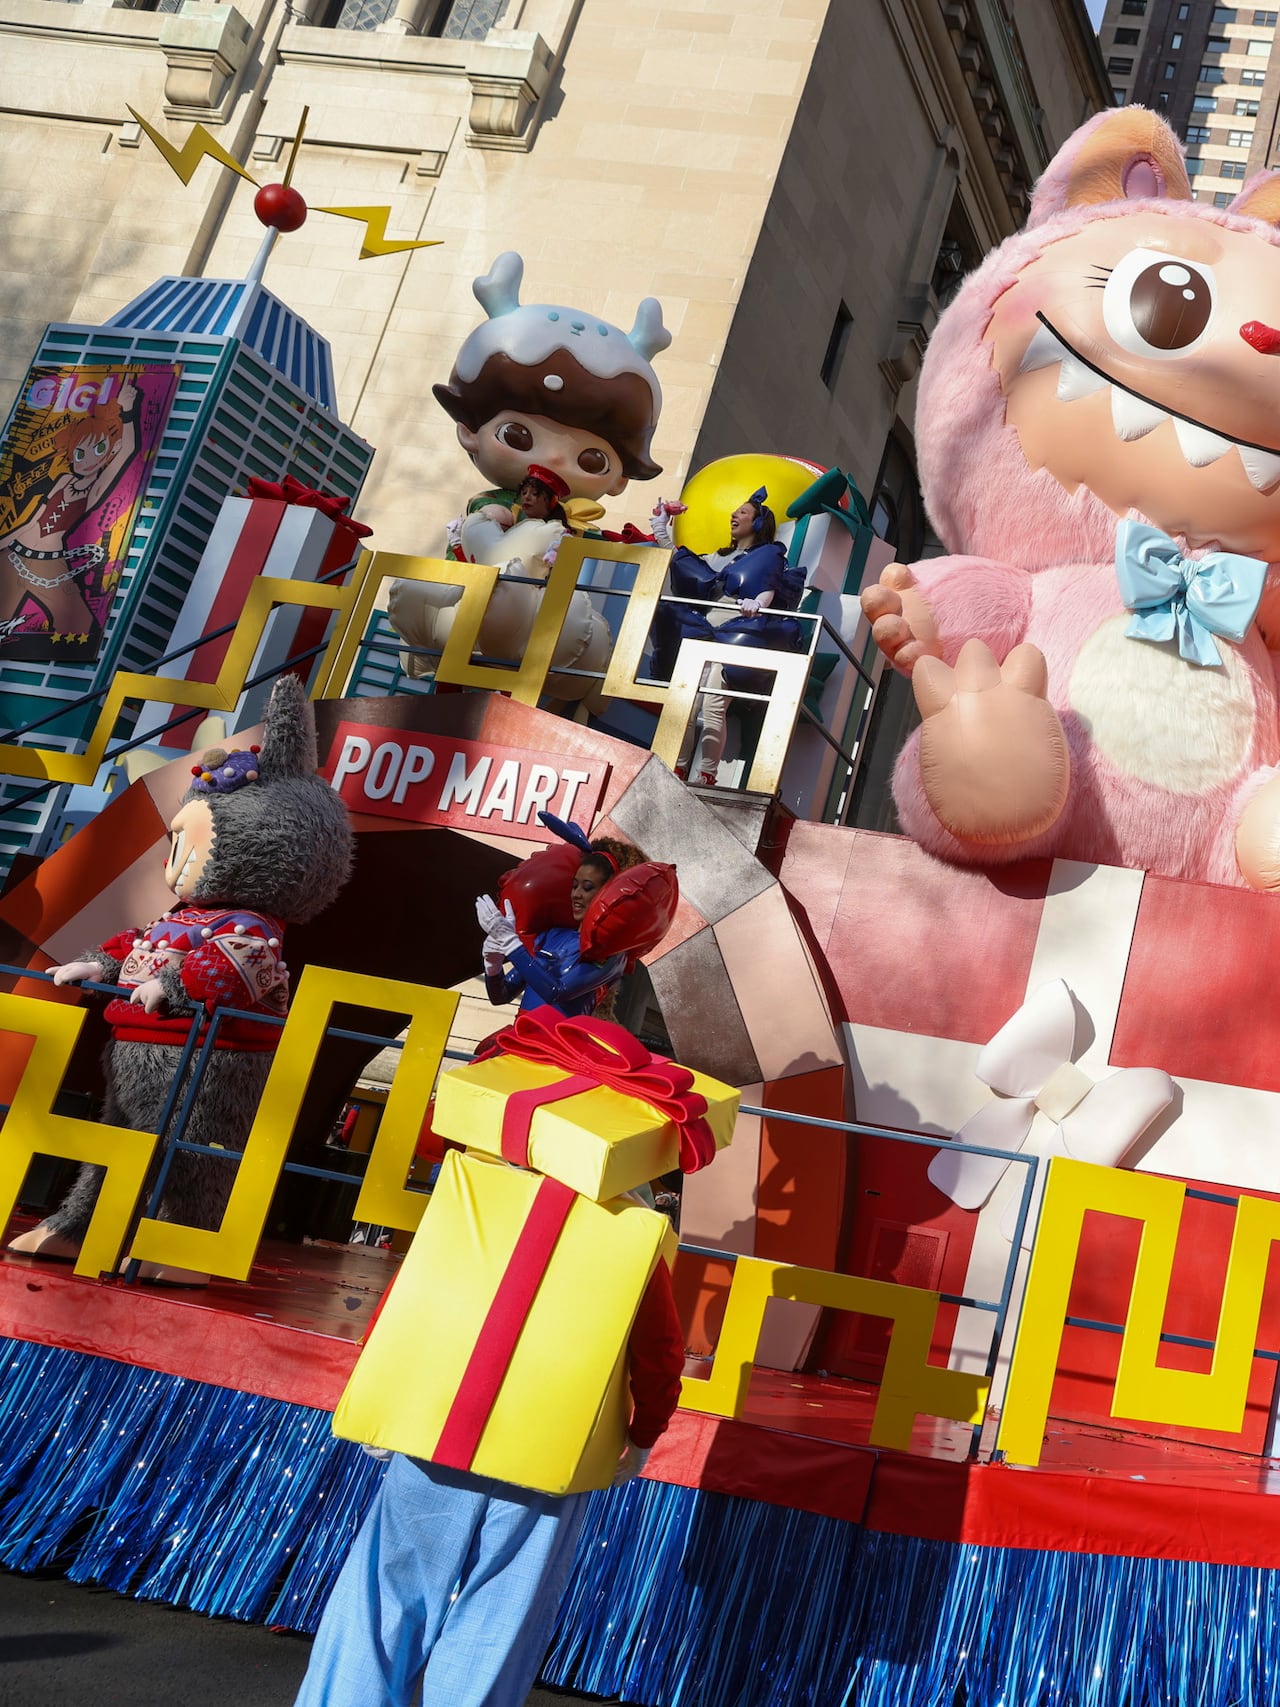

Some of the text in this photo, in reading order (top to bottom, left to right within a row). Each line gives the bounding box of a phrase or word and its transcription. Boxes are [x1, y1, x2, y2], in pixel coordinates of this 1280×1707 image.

[27, 377, 114, 413] GIGI
[31, 413, 71, 442] PEACH
[331, 735, 590, 828] POP MART
